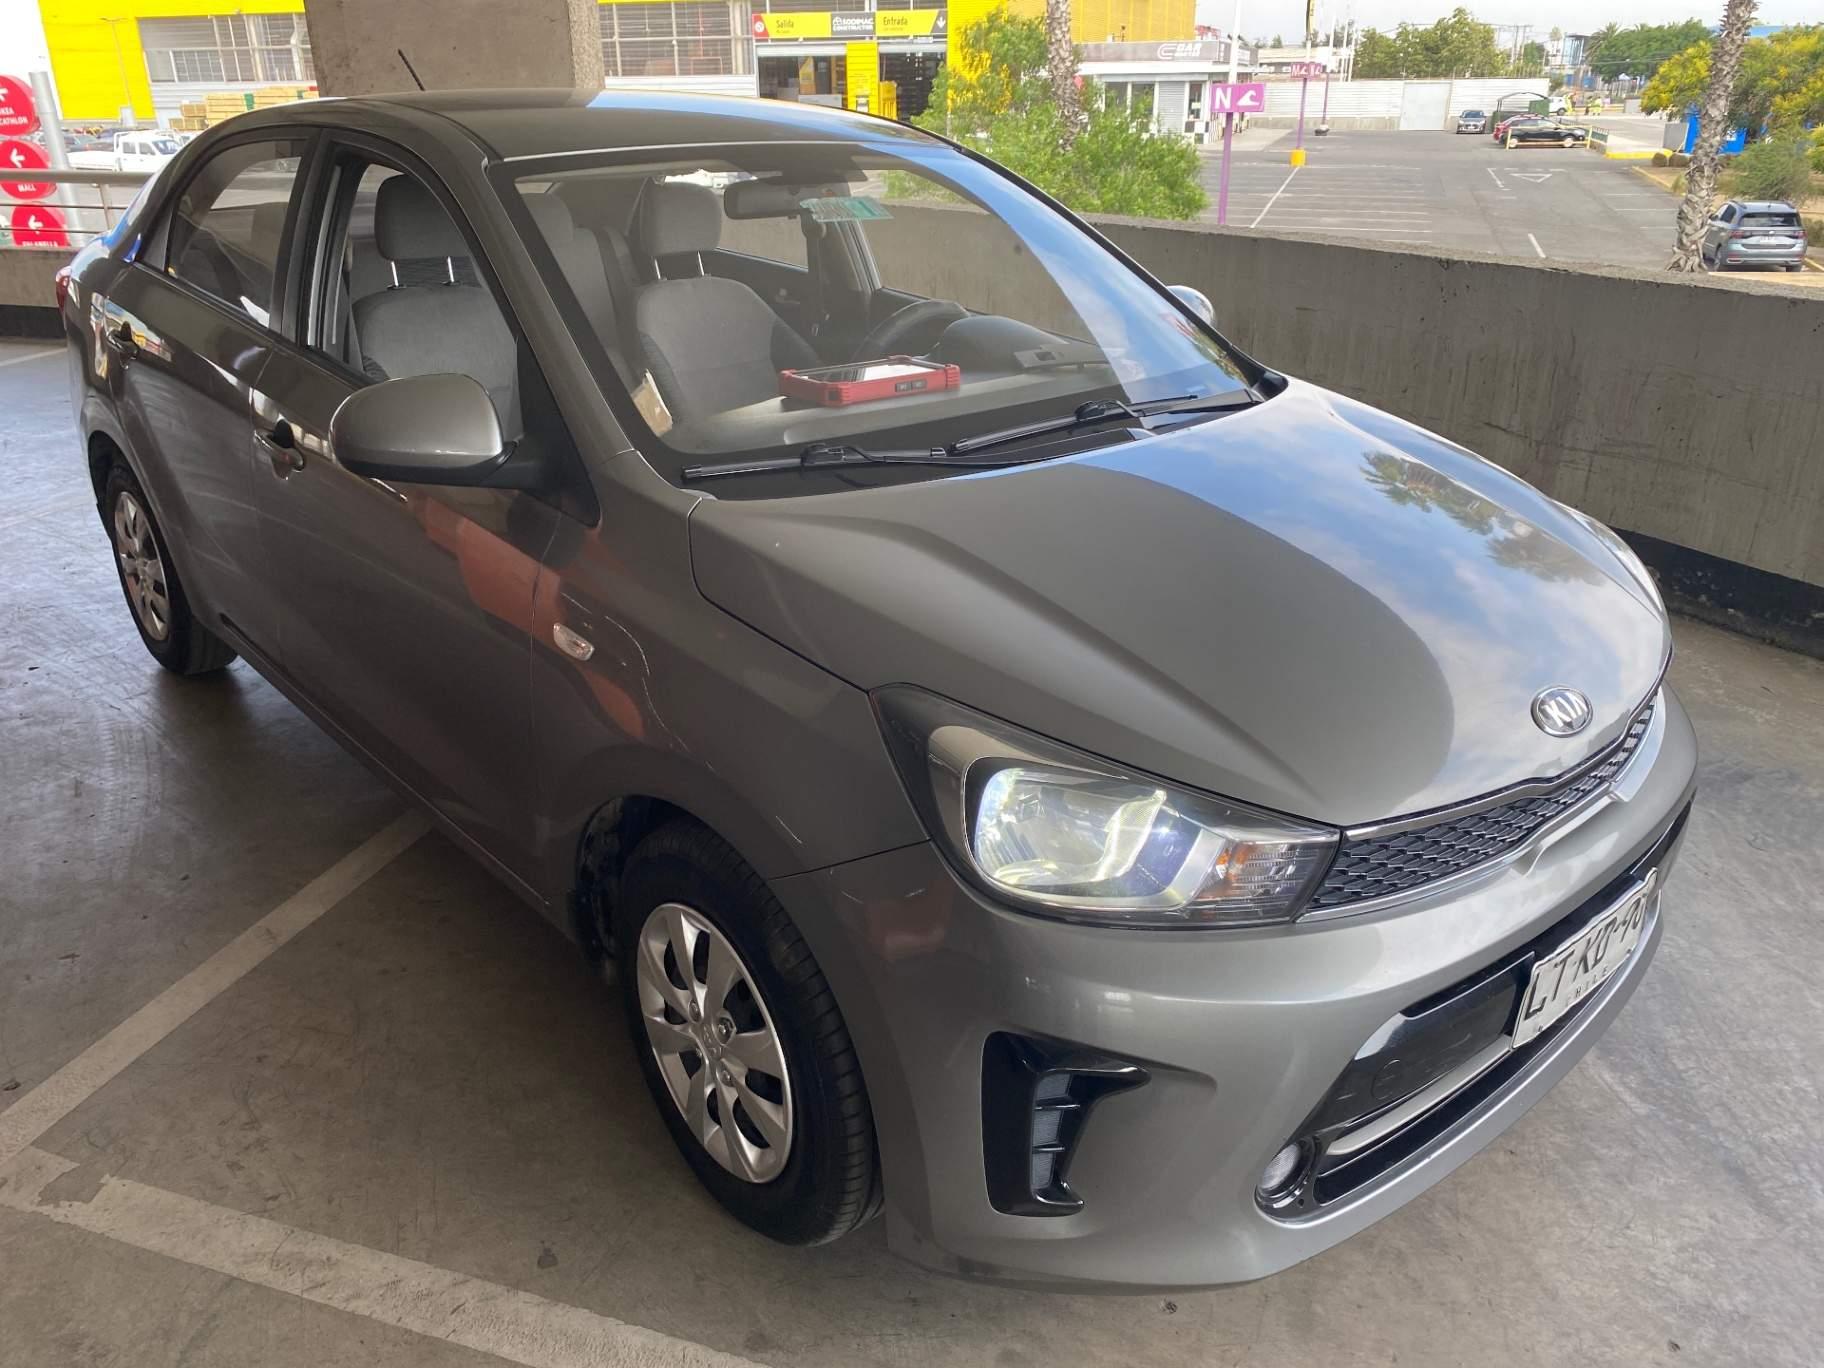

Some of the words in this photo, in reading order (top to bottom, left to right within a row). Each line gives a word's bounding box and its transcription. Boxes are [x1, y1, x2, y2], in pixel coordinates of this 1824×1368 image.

[883, 16, 908, 26] Entrada
[1214, 87, 1231, 109] N
[17, 183, 36, 192] MALL
